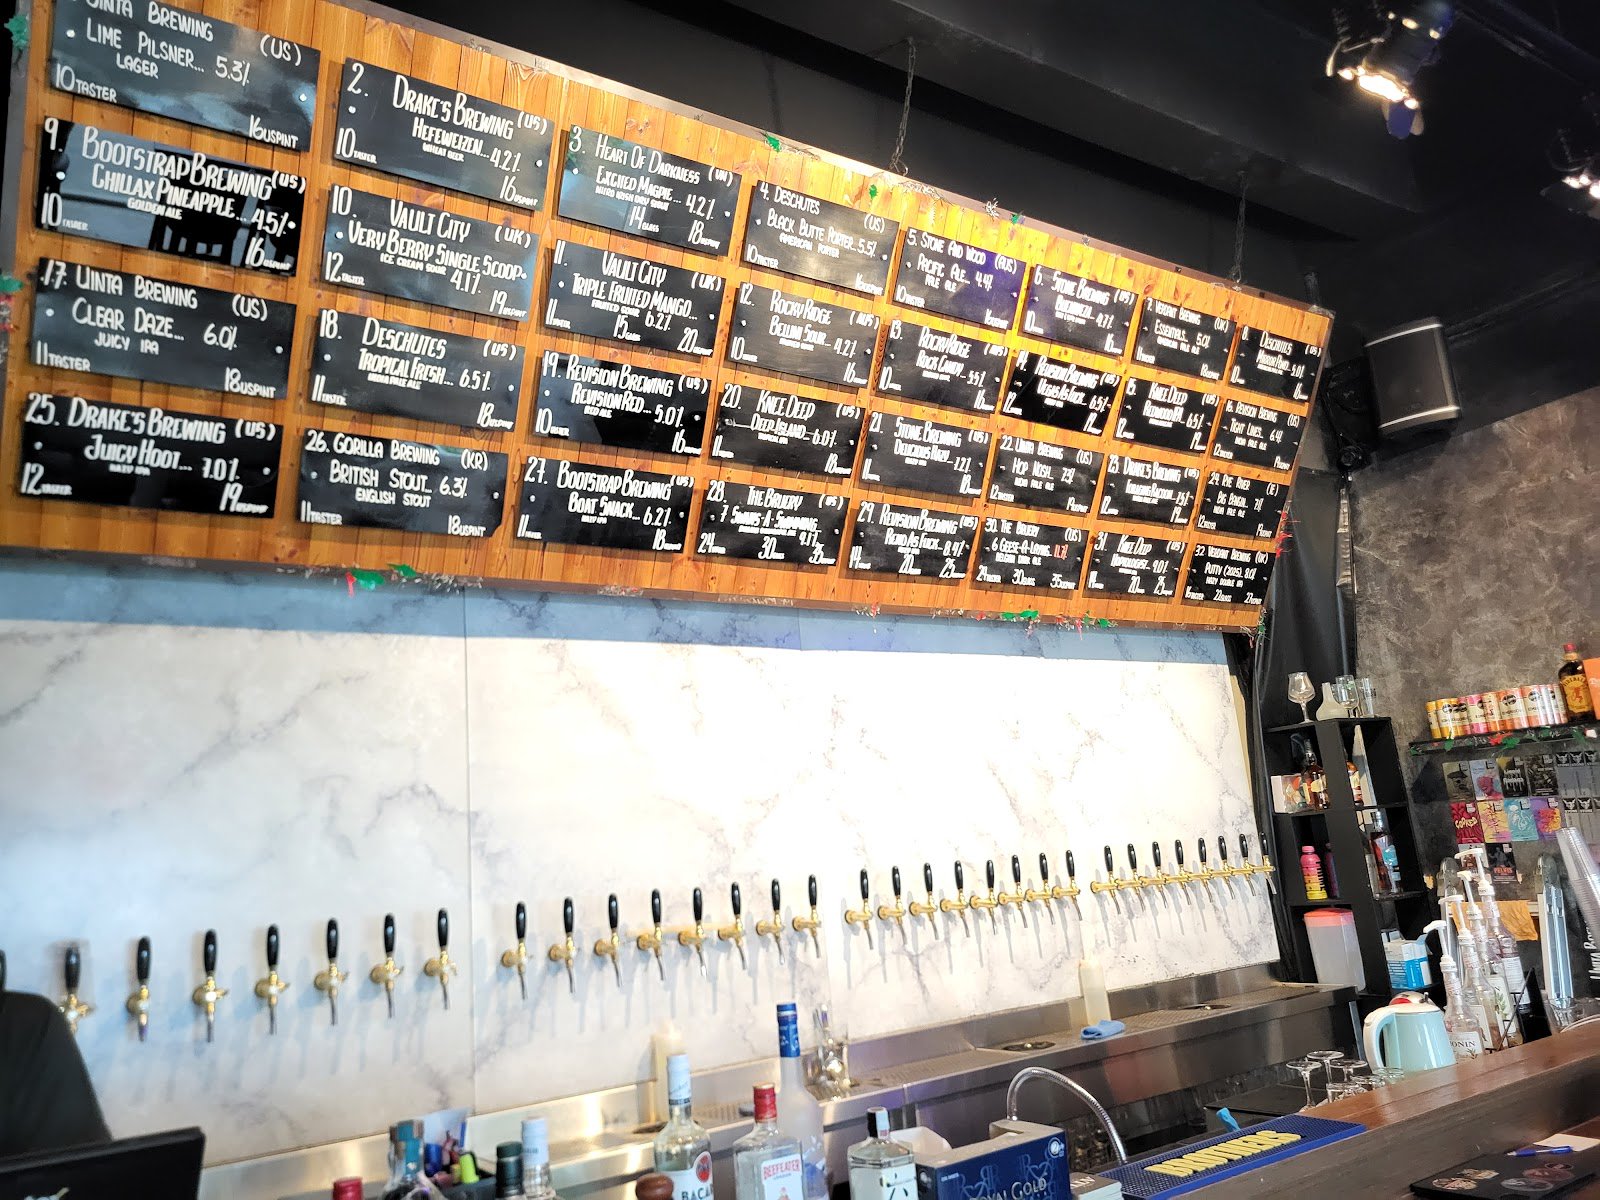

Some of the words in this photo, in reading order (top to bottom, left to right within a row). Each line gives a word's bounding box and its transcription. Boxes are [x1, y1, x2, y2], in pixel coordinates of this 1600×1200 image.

[86, 18, 122, 49] LIME
[215, 55, 251, 86] 5.3%
[148, 4, 213, 41] BREWING
[260, 35, 301, 66] (US)
[117, 53, 158, 79] LAGER
[347, 63, 368, 97] 2.
[393, 75, 451, 123] DRAKE'S
[453, 93, 513, 140] BREWING
[82, 126, 190, 181] BOOTSTRAP
[190, 153, 272, 201] BREWING
[272, 170, 306, 194] (US)
[490, 148, 521, 173] 4.2%
[569, 126, 585, 153] 3.
[595, 134, 628, 164] HEART
[630, 146, 646, 169] OF
[648, 151, 700, 185] DARKNESS
[92, 164, 155, 200] CHILLAX
[251, 208, 288, 237] 4.5%
[331, 185, 357, 217] 10.
[390, 199, 435, 235] VAULT
[437, 212, 471, 243] CITY
[774, 186, 820, 215] DESCHUTES
[864, 214, 885, 233] (US)
[767, 208, 795, 233] BLACK
[799, 218, 825, 241] BUTTE
[921, 232, 945, 254] STONE
[349, 219, 386, 249] VERY
[387, 229, 434, 260] BERRY
[435, 244, 480, 273] SINGLE
[482, 255, 521, 281] SCOOP
[380, 253, 394, 264] ICE
[602, 251, 637, 282] VAULT
[638, 261, 667, 288] CITY
[76, 265, 123, 296] UINTA
[134, 275, 198, 309] BREWING
[231, 294, 267, 322] (US)
[572, 273, 607, 300] TRIPLE
[608, 282, 650, 310] FRUITED
[72, 297, 125, 332] CLEAR
[203, 323, 238, 350] 6.0%
[320, 310, 342, 339] 18.
[362, 318, 447, 359] DESCHUTES
[94, 332, 130, 351] JUICY
[140, 340, 159, 355] IPA
[358, 348, 411, 378] TROPICAL
[543, 351, 561, 378] 19.
[566, 354, 620, 389] REVISION
[619, 364, 673, 397] BREWING
[571, 383, 622, 410] REVISION
[785, 395, 816, 421] DEEP
[25, 393, 59, 426] 25.
[67, 397, 146, 435] DRAKE'S
[148, 407, 226, 444] BREWING
[84, 434, 134, 464] JUICY
[305, 430, 330, 453] 26.
[333, 433, 383, 459] GORILLA
[390, 440, 440, 465] BREWING
[461, 450, 488, 471] (KR)
[1012, 457, 1028, 475] HOP
[329, 460, 379, 487] BRITISH
[439, 477, 467, 498] 6.3%
[524, 456, 548, 484] 27.
[557, 460, 622, 493] BOOTSTRAP
[622, 469, 671, 500] BREWING
[355, 488, 396, 504] ENGLISH
[403, 494, 431, 507] STOUT
[568, 491, 599, 515] BOAT
[763, 1159, 800, 1180] BEEFEATER
[1012, 1173, 1047, 1200] GOLD
